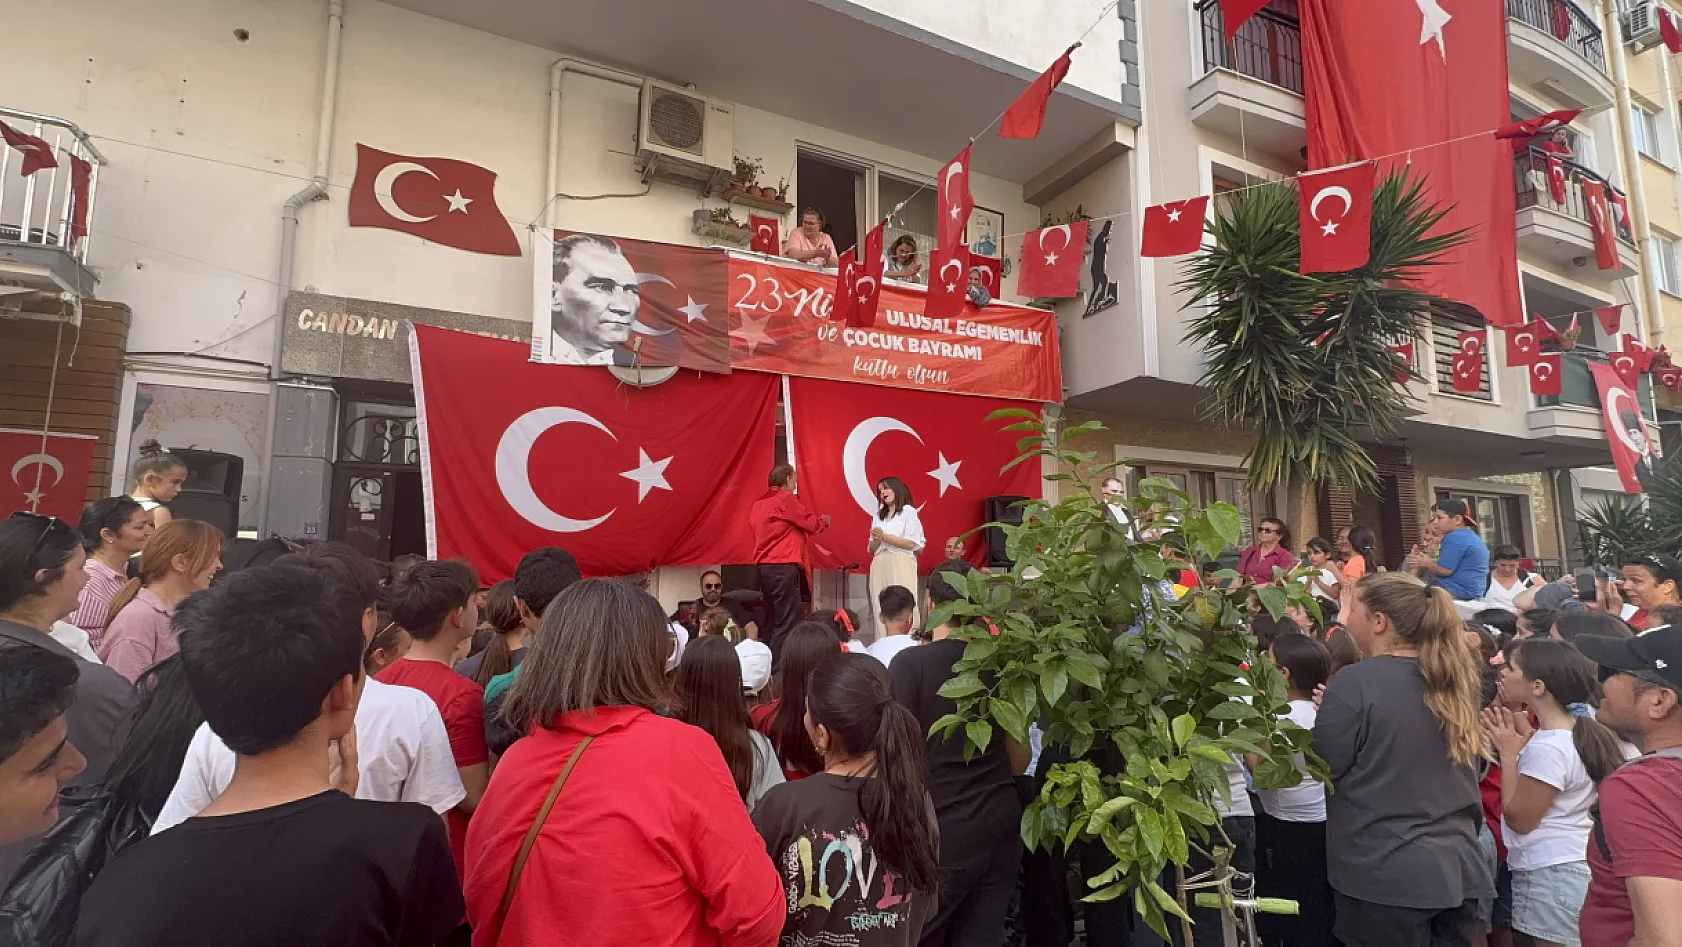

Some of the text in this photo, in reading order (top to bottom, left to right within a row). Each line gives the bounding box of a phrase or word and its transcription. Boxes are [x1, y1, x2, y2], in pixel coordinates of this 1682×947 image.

[734, 272, 783, 313] 23
[298, 308, 399, 340] CANDAN
[817, 322, 983, 361] ve ÇOCUK BAYRAMI
[886, 308, 1044, 347] ULUSAL EGEMENLİK
[853, 355, 950, 385] kutlu olsun
